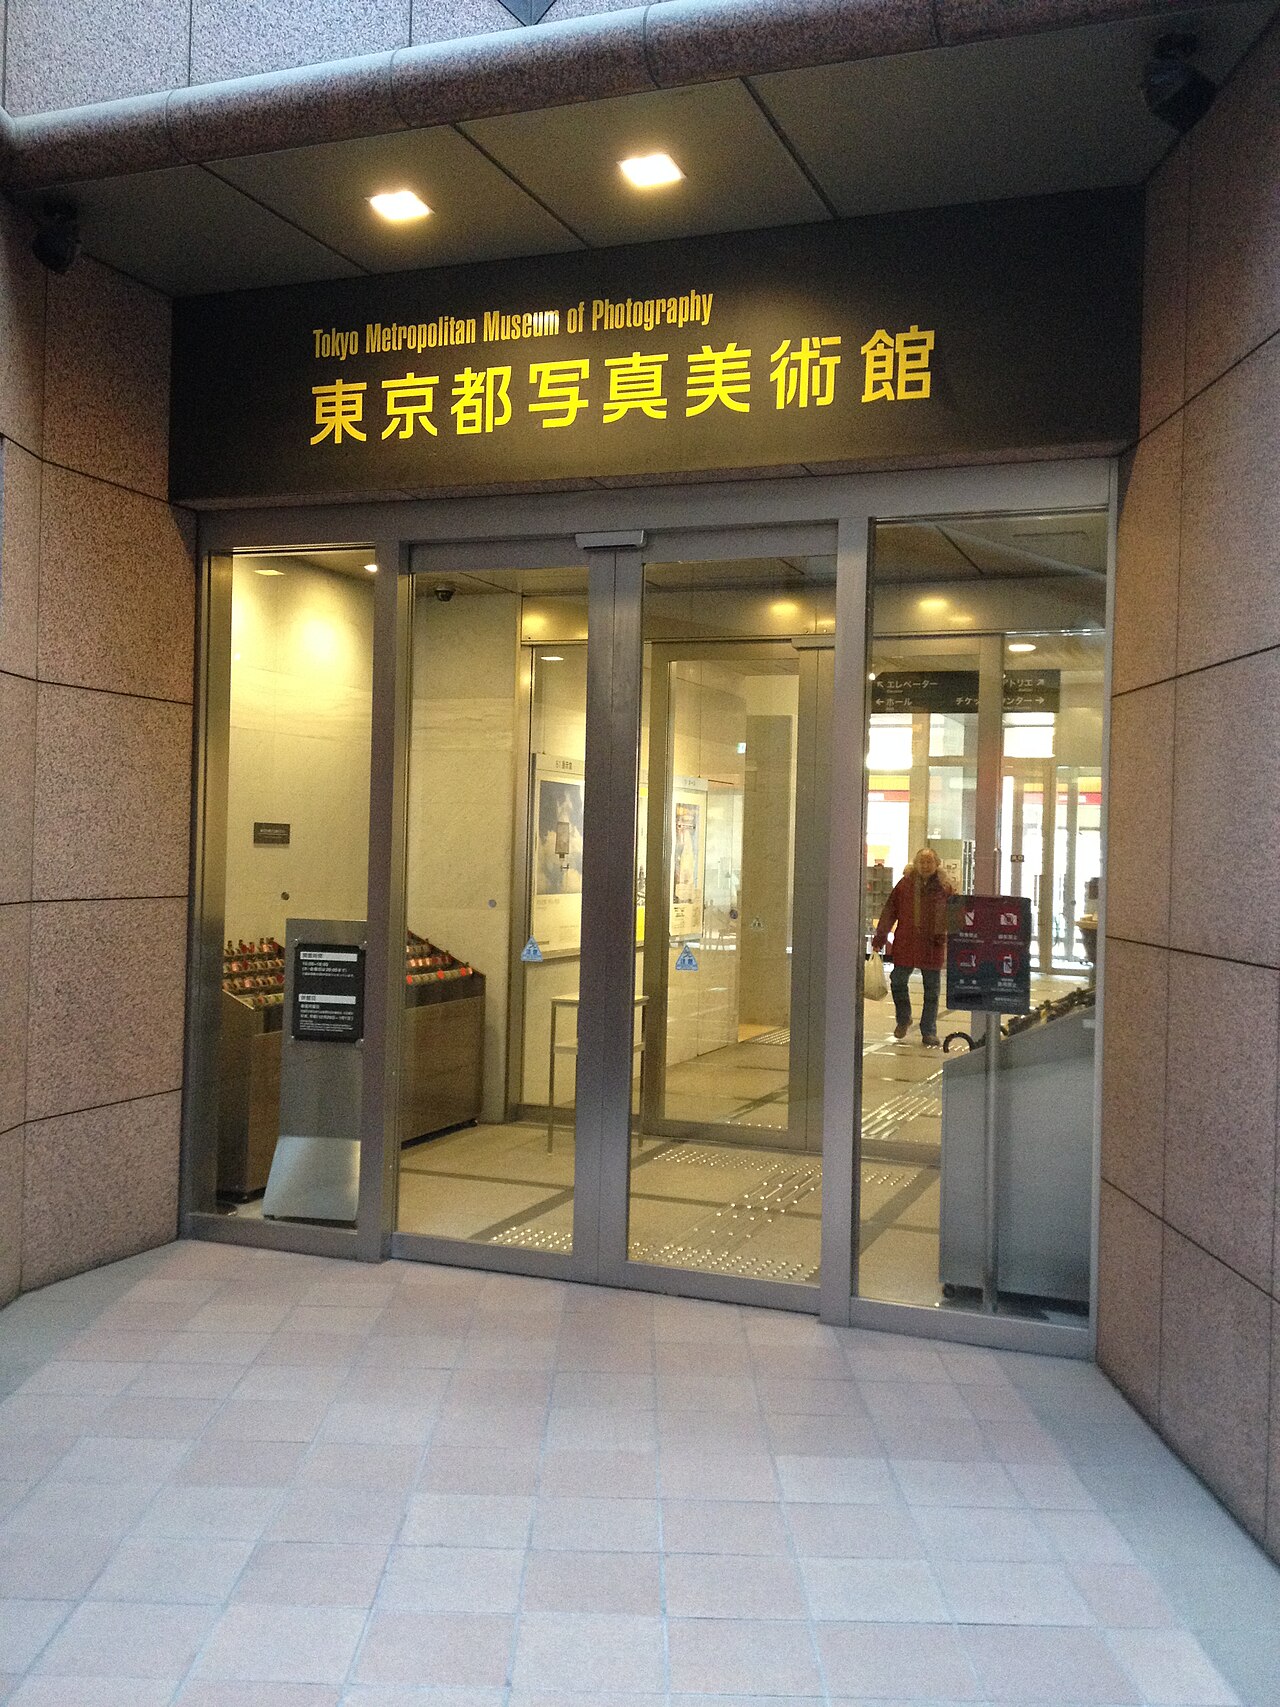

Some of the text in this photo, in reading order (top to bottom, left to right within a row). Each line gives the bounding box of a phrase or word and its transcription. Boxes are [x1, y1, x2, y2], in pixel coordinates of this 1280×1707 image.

[313, 290, 714, 361] Tokyo Metropolitan Museum of Photography
[310, 325, 935, 446] 東京都写真美術館
[886, 679, 938, 690] エレベーター
[886, 697, 913, 707] ホール
